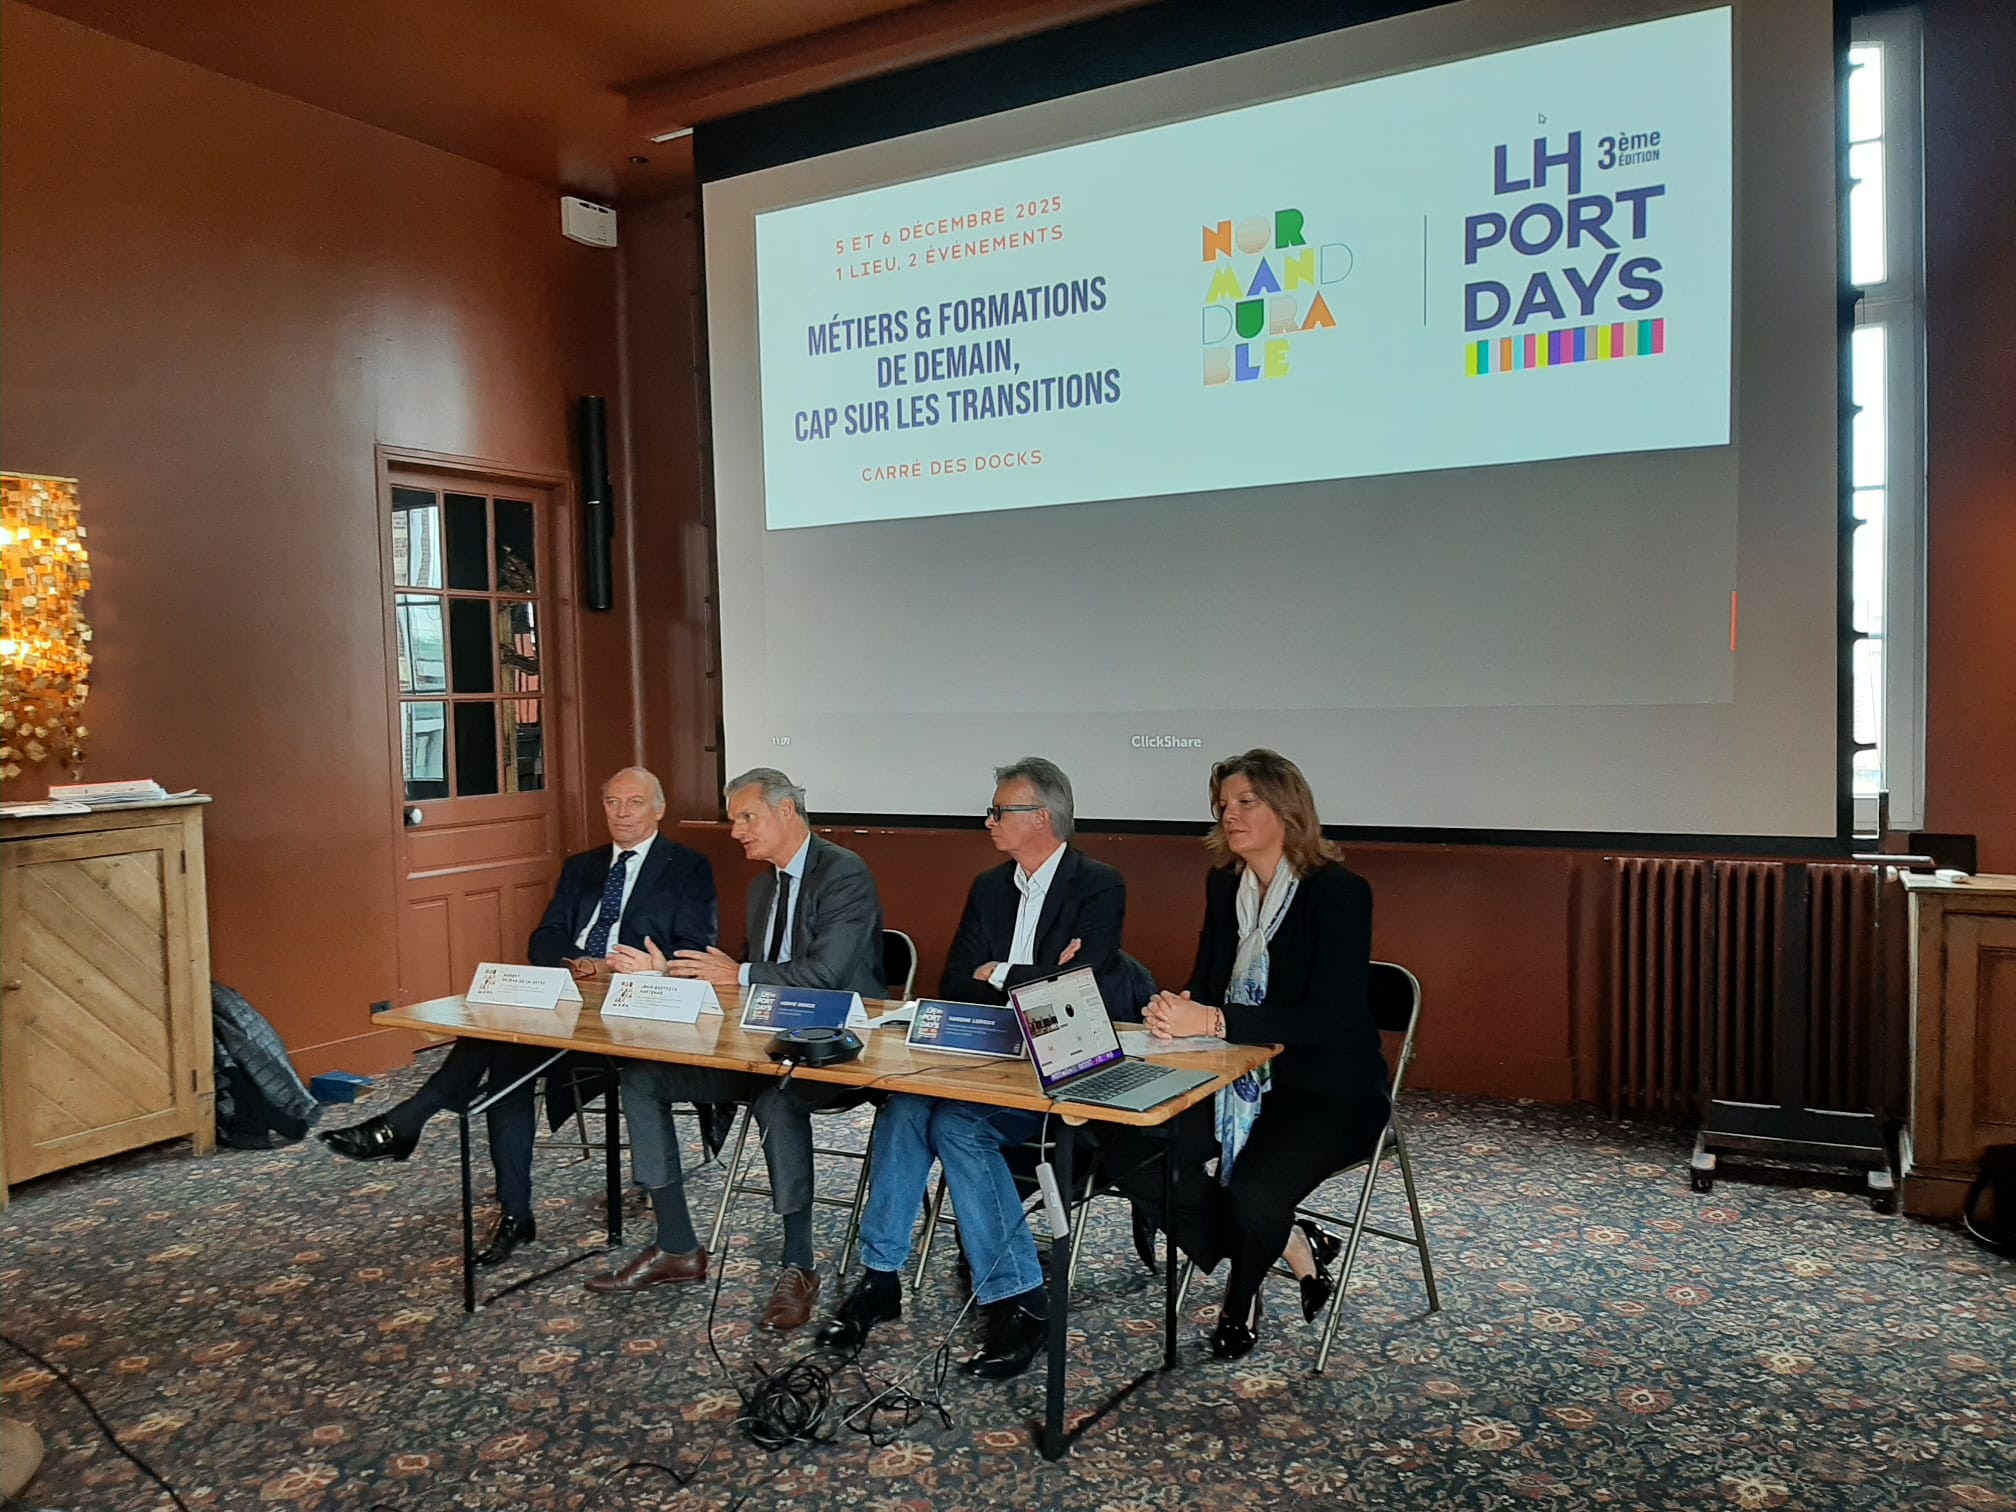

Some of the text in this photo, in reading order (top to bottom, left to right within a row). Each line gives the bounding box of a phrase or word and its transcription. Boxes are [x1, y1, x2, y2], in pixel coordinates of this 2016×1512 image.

[1494, 130, 1582, 195] LH
[1598, 131, 1661, 170] 3ème
[1618, 149, 1660, 167] ÉDITION
[836, 196, 1062, 255] 5 ET 6 DÉCEMBRE 2025
[1203, 208, 1306, 262] NOR
[1465, 184, 1665, 265] PORT
[836, 225, 1063, 280] 1 LIEU, 2 ÉVÉNEMENTS
[1205, 243, 1353, 305] MAND
[808, 276, 1107, 356] MÉTIERS & FORMATIONS
[1203, 290, 1337, 345] DURA
[1465, 252, 1664, 332] DAYS
[877, 338, 1020, 388] DE DEMAIN,
[1203, 339, 1291, 386] BLE
[795, 368, 1121, 442] CAP SUR LES TRANSITIONS
[862, 450, 1042, 482] CARRÉ DES DOCKS
[1131, 735, 1202, 748] ClickShare
